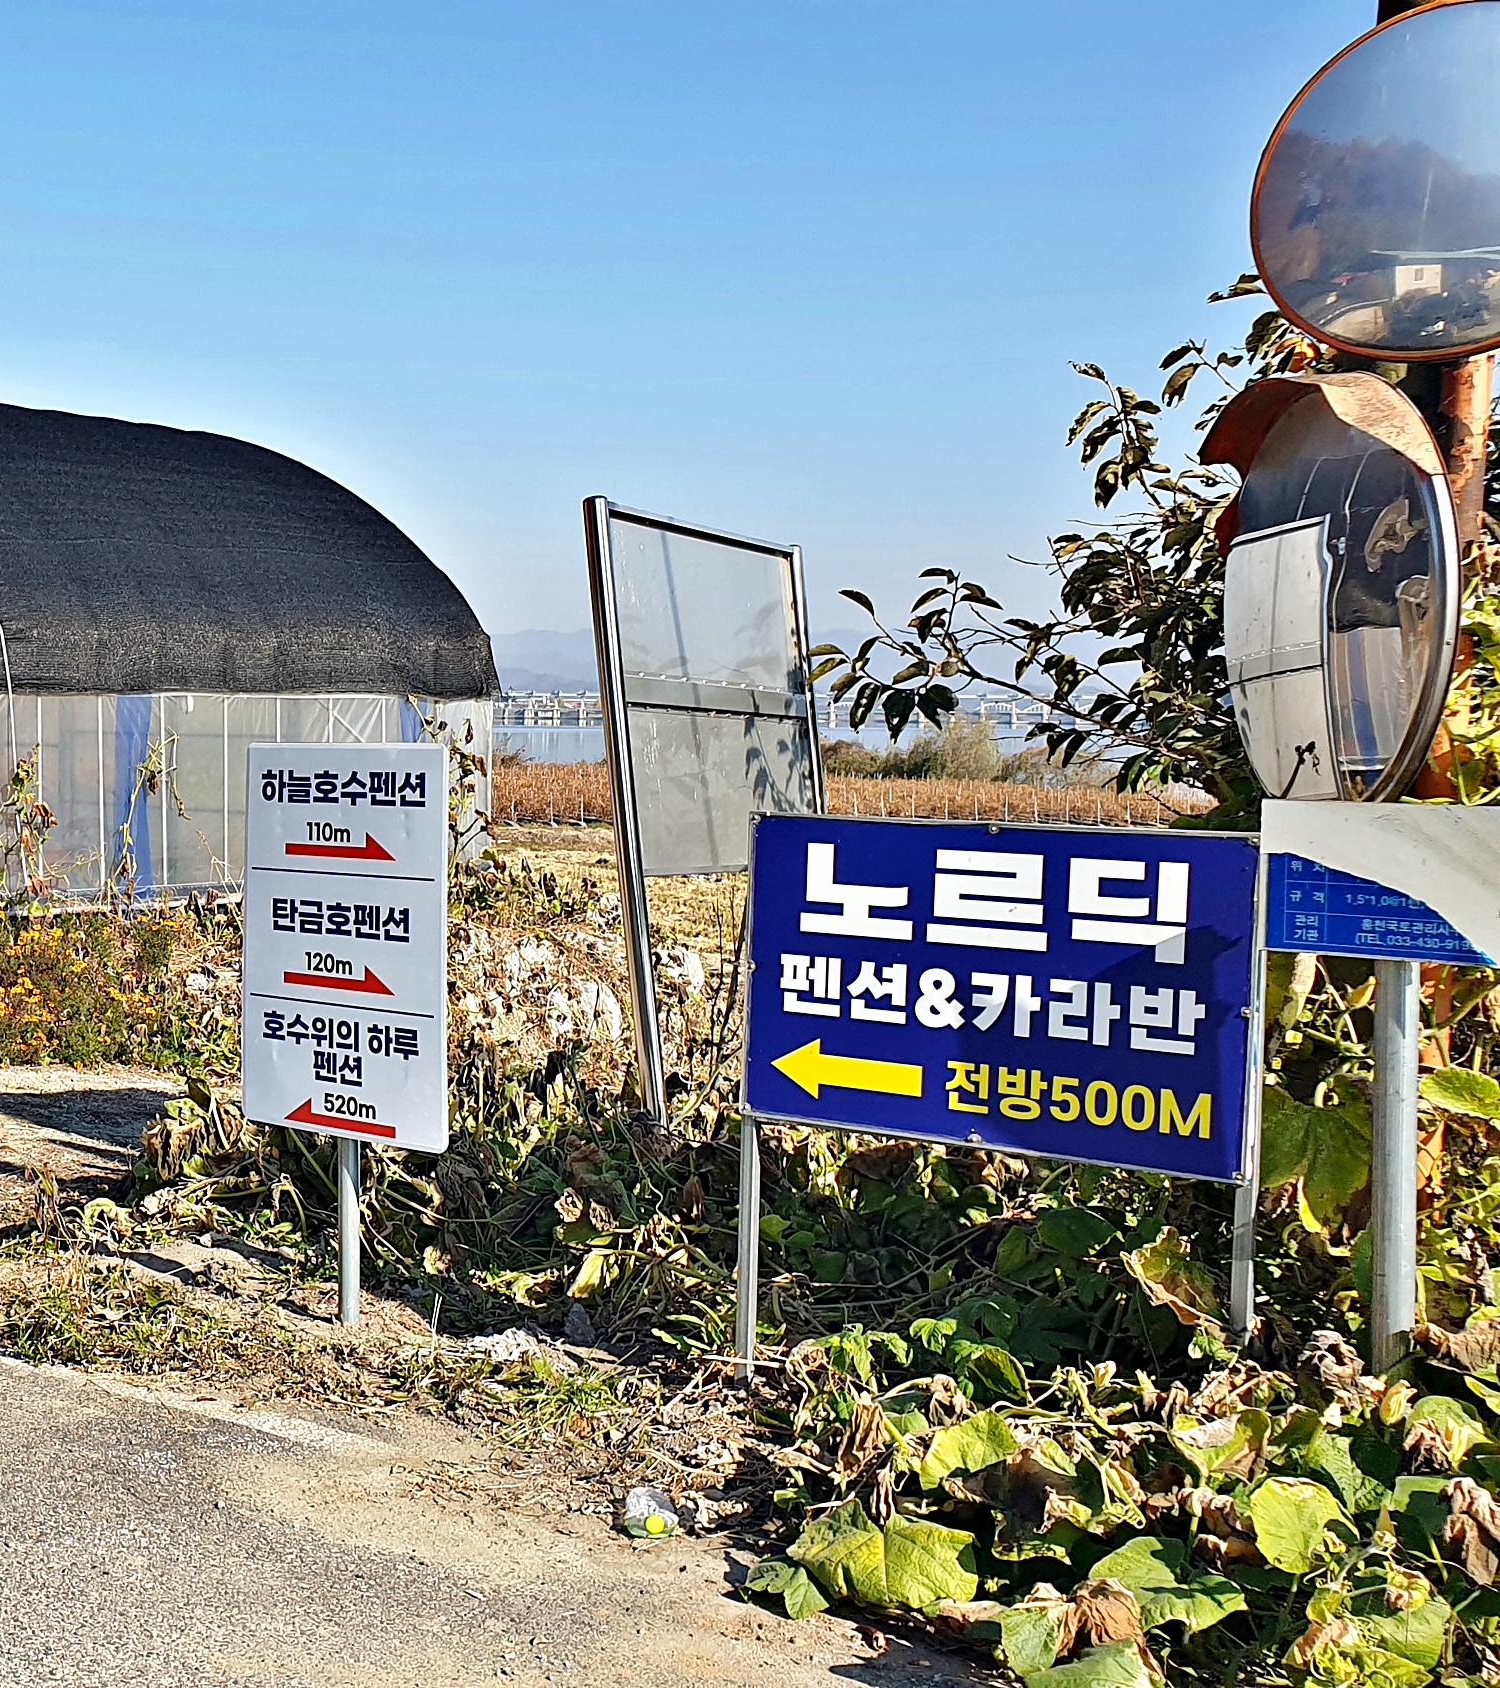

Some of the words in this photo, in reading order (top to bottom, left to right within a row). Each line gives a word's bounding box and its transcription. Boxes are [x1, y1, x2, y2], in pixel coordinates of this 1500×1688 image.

[261, 769, 427, 808] 하늘호수펜션
[306, 822, 351, 844] 110m
[272, 897, 410, 943] 탄금호펜션
[800, 842, 1190, 965] 노르딕
[304, 951, 353, 976] 120m
[780, 953, 1205, 1056] 펜션&카라반
[262, 1010, 360, 1054] 호수위의
[367, 1023, 420, 1061] 하루
[312, 1049, 363, 1087] 펜션
[323, 1091, 376, 1120] 520m
